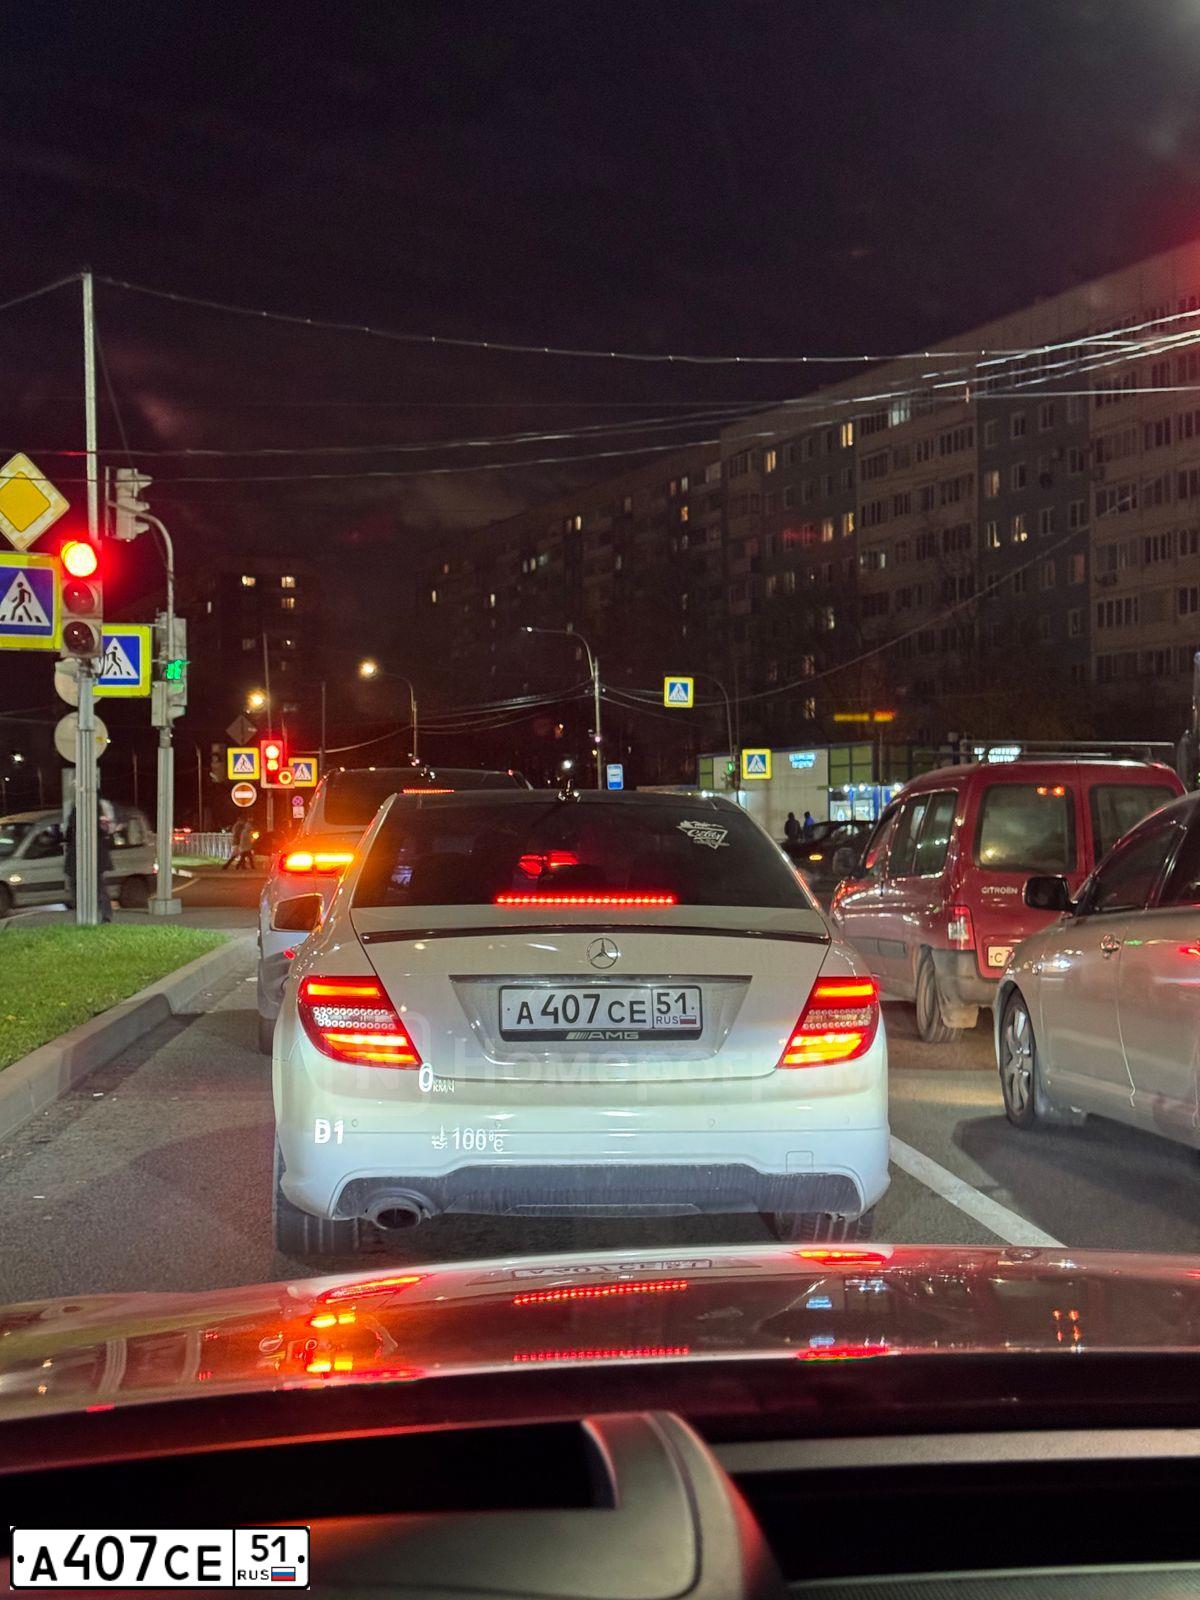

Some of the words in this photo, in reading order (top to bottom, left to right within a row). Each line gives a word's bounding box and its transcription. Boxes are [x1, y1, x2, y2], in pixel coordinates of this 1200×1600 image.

[516, 993, 647, 1025] А407СЕ
[656, 992, 687, 1015] 51
[655, 1015, 679, 1025] RUS
[587, 1031, 639, 1040] AMG
[314, 1118, 344, 1145] D1
